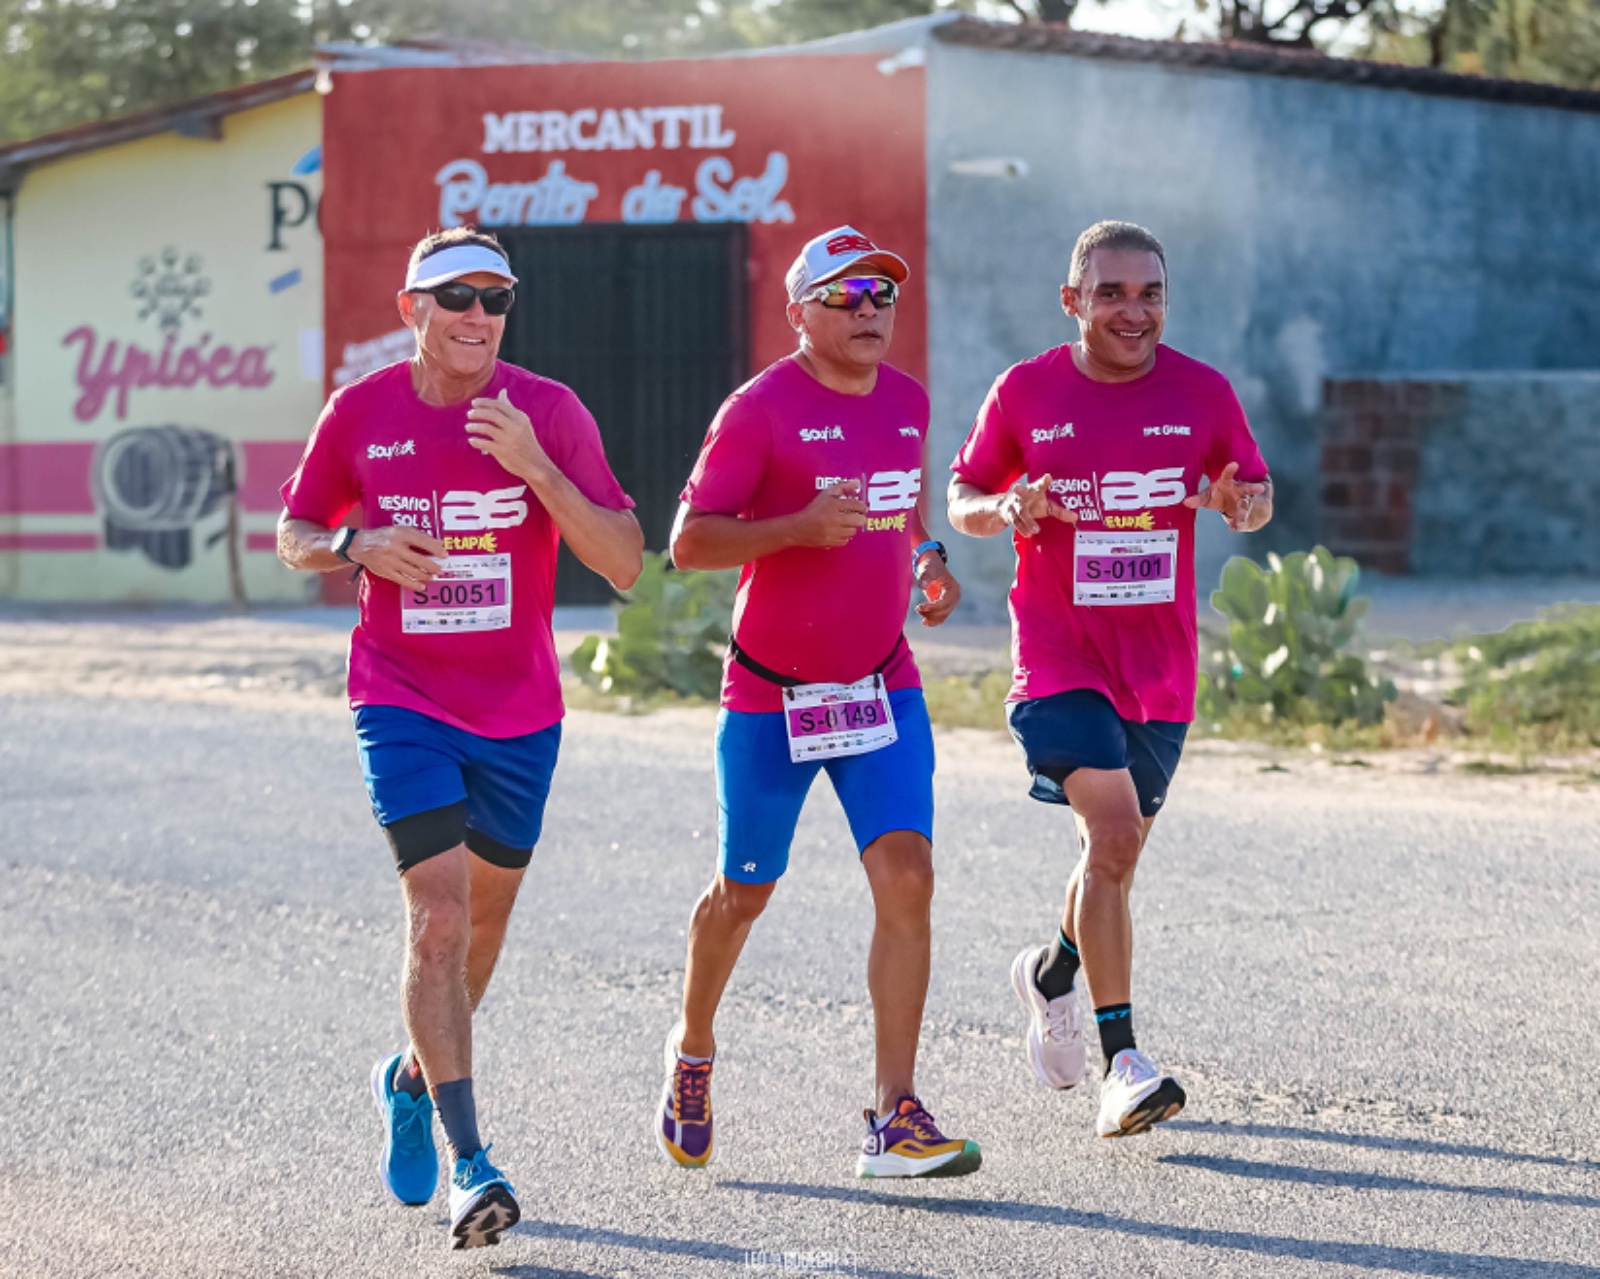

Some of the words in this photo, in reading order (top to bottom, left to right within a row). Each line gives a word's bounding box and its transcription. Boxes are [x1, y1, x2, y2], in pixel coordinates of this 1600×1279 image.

[482, 104, 736, 153] MERCANTIL
[692, 151, 795, 224] Sol
[60, 325, 276, 422] Ypióca
[1086, 558, 1162, 579] S-0101
[413, 584, 496, 605] S-0051
[799, 704, 877, 732] S-0149
